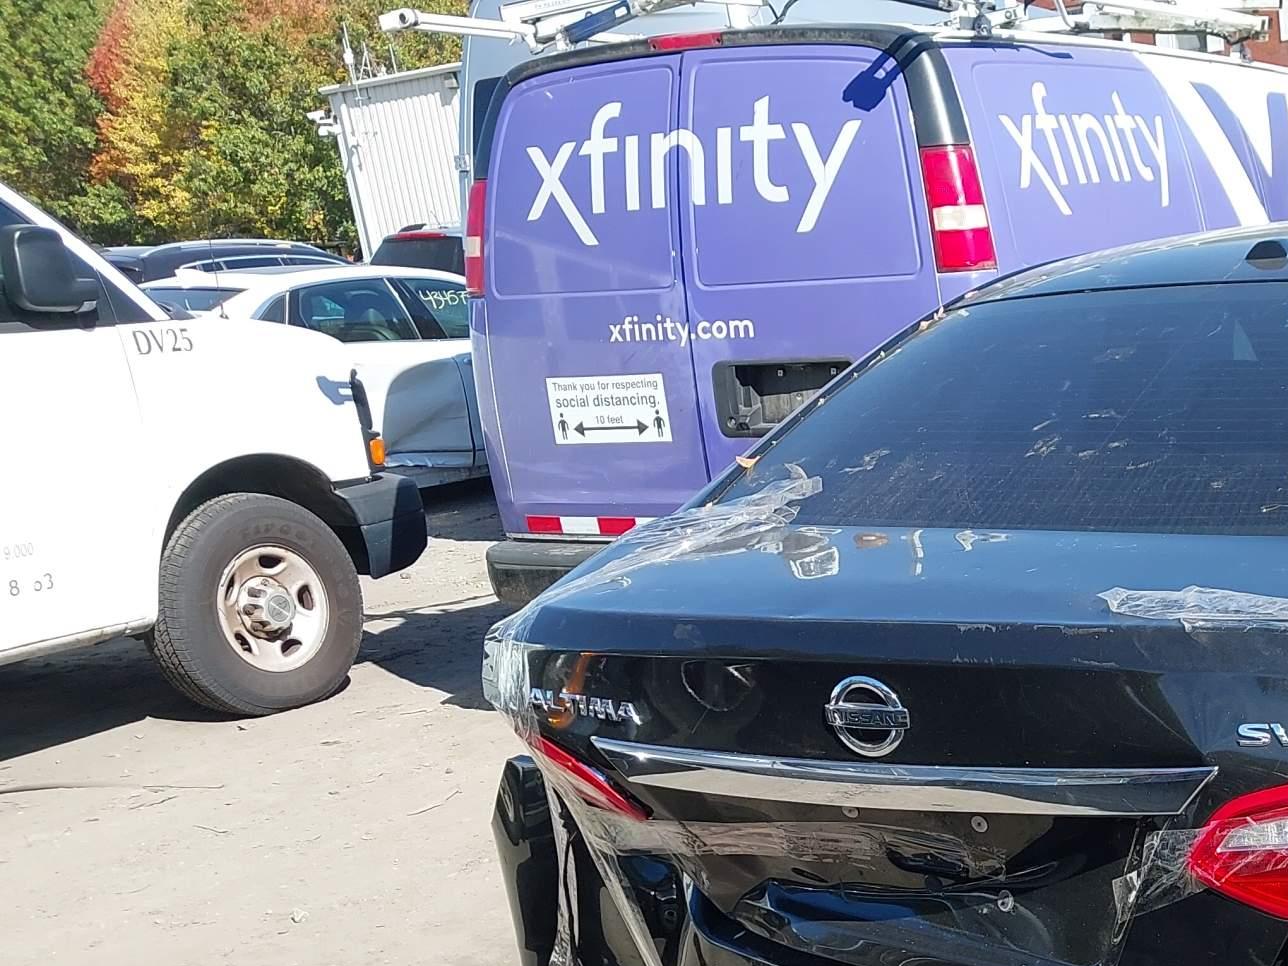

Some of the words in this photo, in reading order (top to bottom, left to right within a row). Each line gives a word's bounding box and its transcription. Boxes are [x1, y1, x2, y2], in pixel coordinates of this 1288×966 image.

[998, 82, 1169, 216] xfinity
[526, 96, 862, 246] xfinity
[132, 328, 193, 355] DV25
[608, 315, 755, 347] xfinity.com
[552, 381, 577, 392] Thank
[580, 383, 595, 392] you
[597, 380, 609, 390] for
[611, 379, 658, 390] respecting
[555, 395, 590, 408] social
[593, 393, 660, 408] distancing.
[595, 415, 605, 425] 10
[607, 414, 624, 424] feet
[530, 687, 642, 726] ALTIMA
[828, 708, 903, 727] NISSAN
